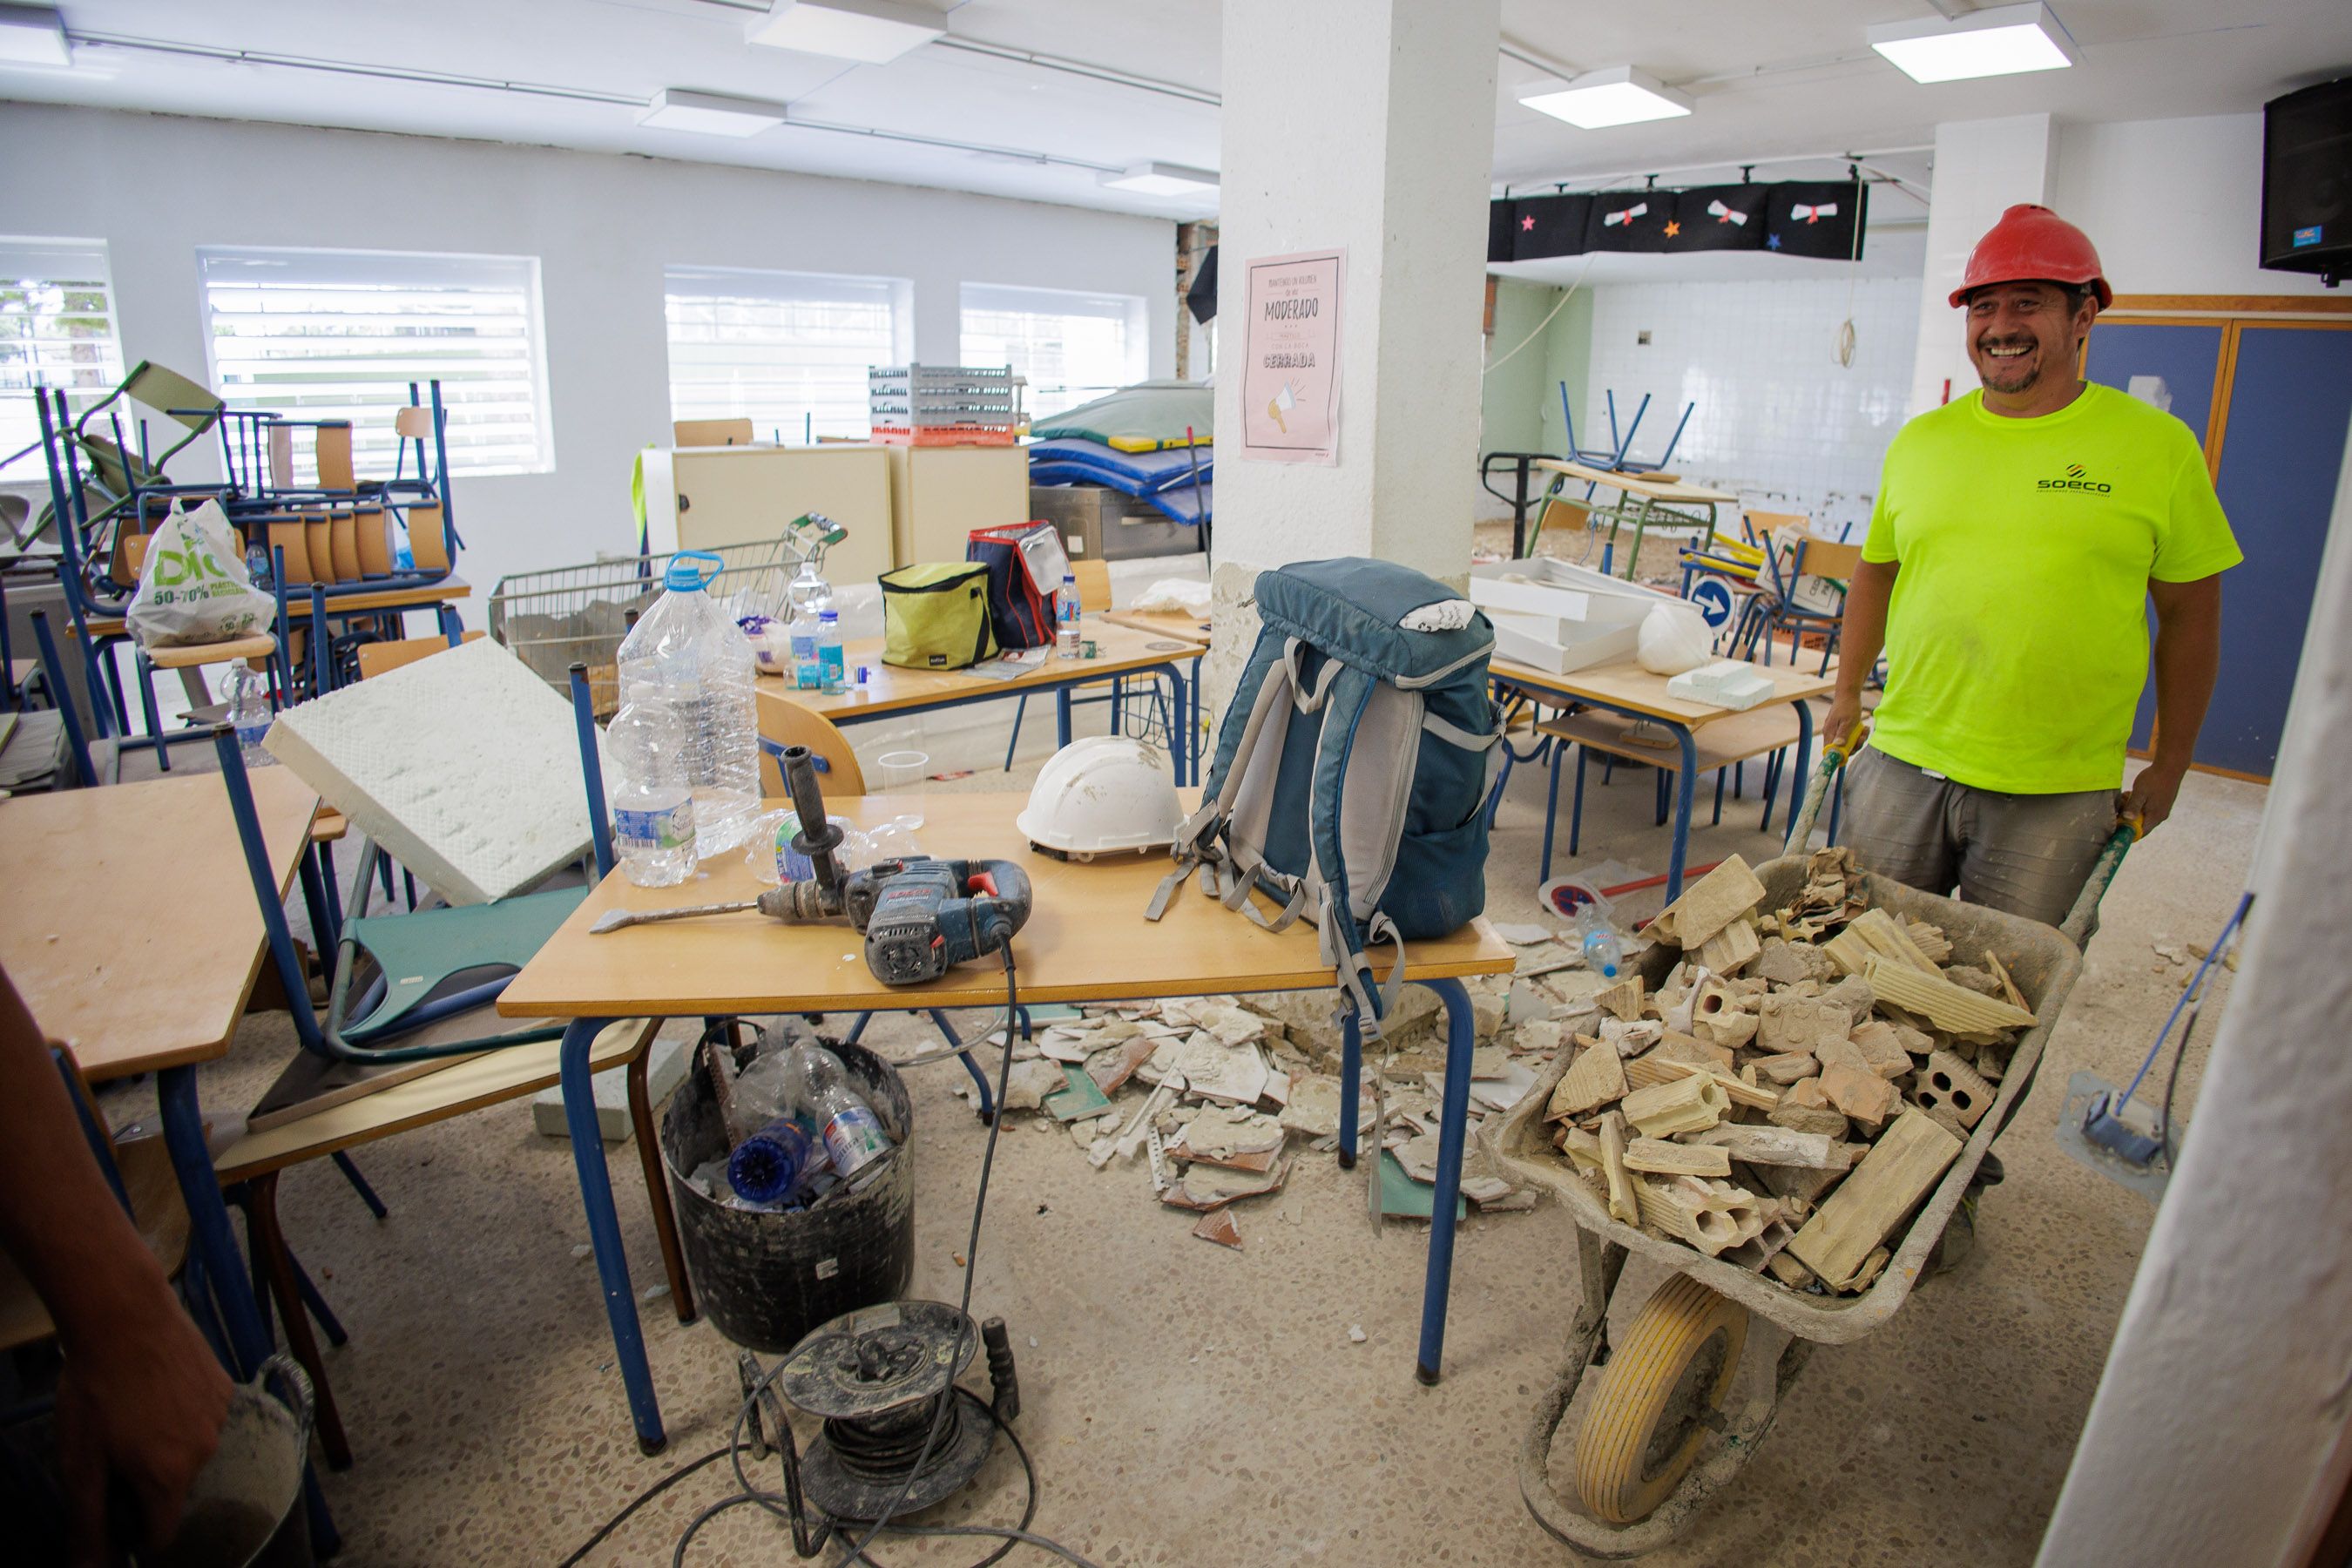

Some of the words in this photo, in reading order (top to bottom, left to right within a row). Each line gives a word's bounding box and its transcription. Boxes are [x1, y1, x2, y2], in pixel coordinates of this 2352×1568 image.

[1264, 297, 1319, 321] MODERADO
[1264, 353, 1315, 368] CERRADA
[154, 584, 209, 605] 50-70%
[1809, 578, 1821, 596] CED
